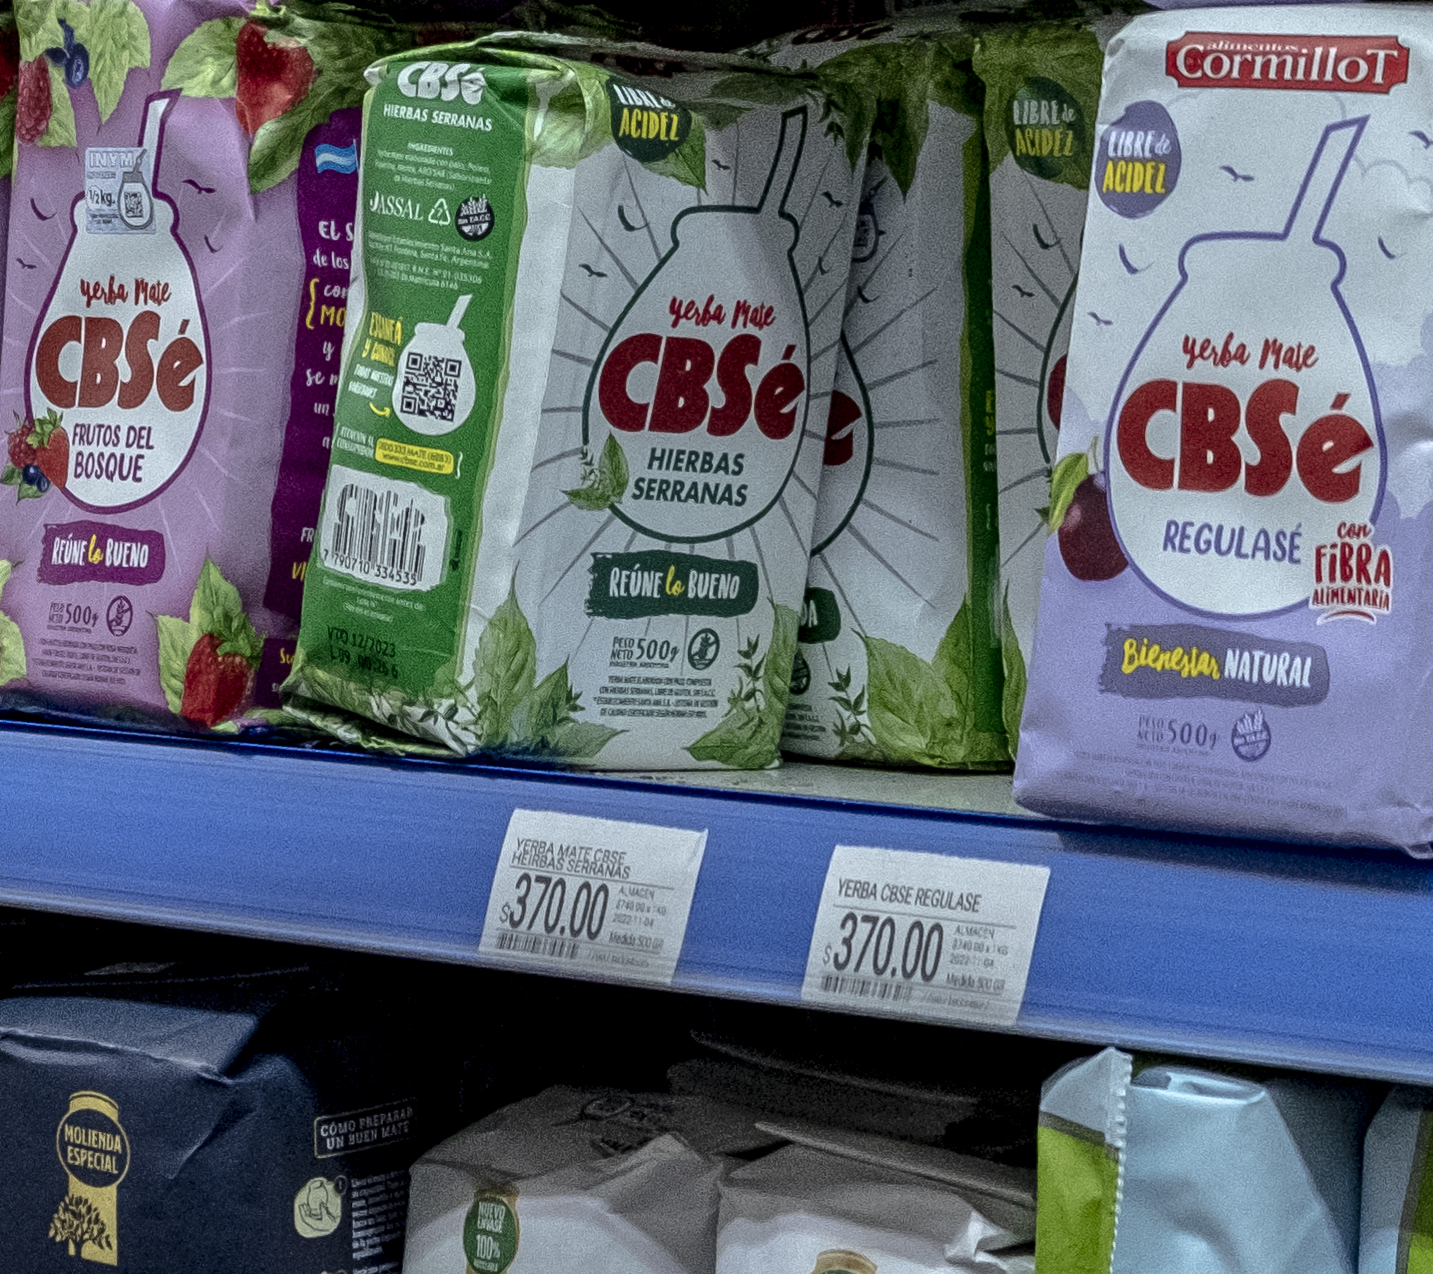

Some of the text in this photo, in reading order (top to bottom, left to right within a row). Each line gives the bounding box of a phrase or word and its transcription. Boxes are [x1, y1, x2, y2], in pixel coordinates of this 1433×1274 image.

[397, 61, 487, 104] CBSé
[383, 103, 492, 131] HIERBAS SERRANAS
[1104, 129, 1156, 159] LIBRE
[1102, 161, 1167, 194] ACIDEZ
[598, 332, 806, 438] CBSé
[1117, 378, 1375, 502] CBSé
[646, 446, 744, 477] HIERBAS
[632, 476, 748, 506] SERRANAS
[1162, 519, 1303, 565] REGULASÉ
[1224, 649, 1313, 688] NATURAL
[838, 879, 980, 913] YERBA CBSE REGULASE
